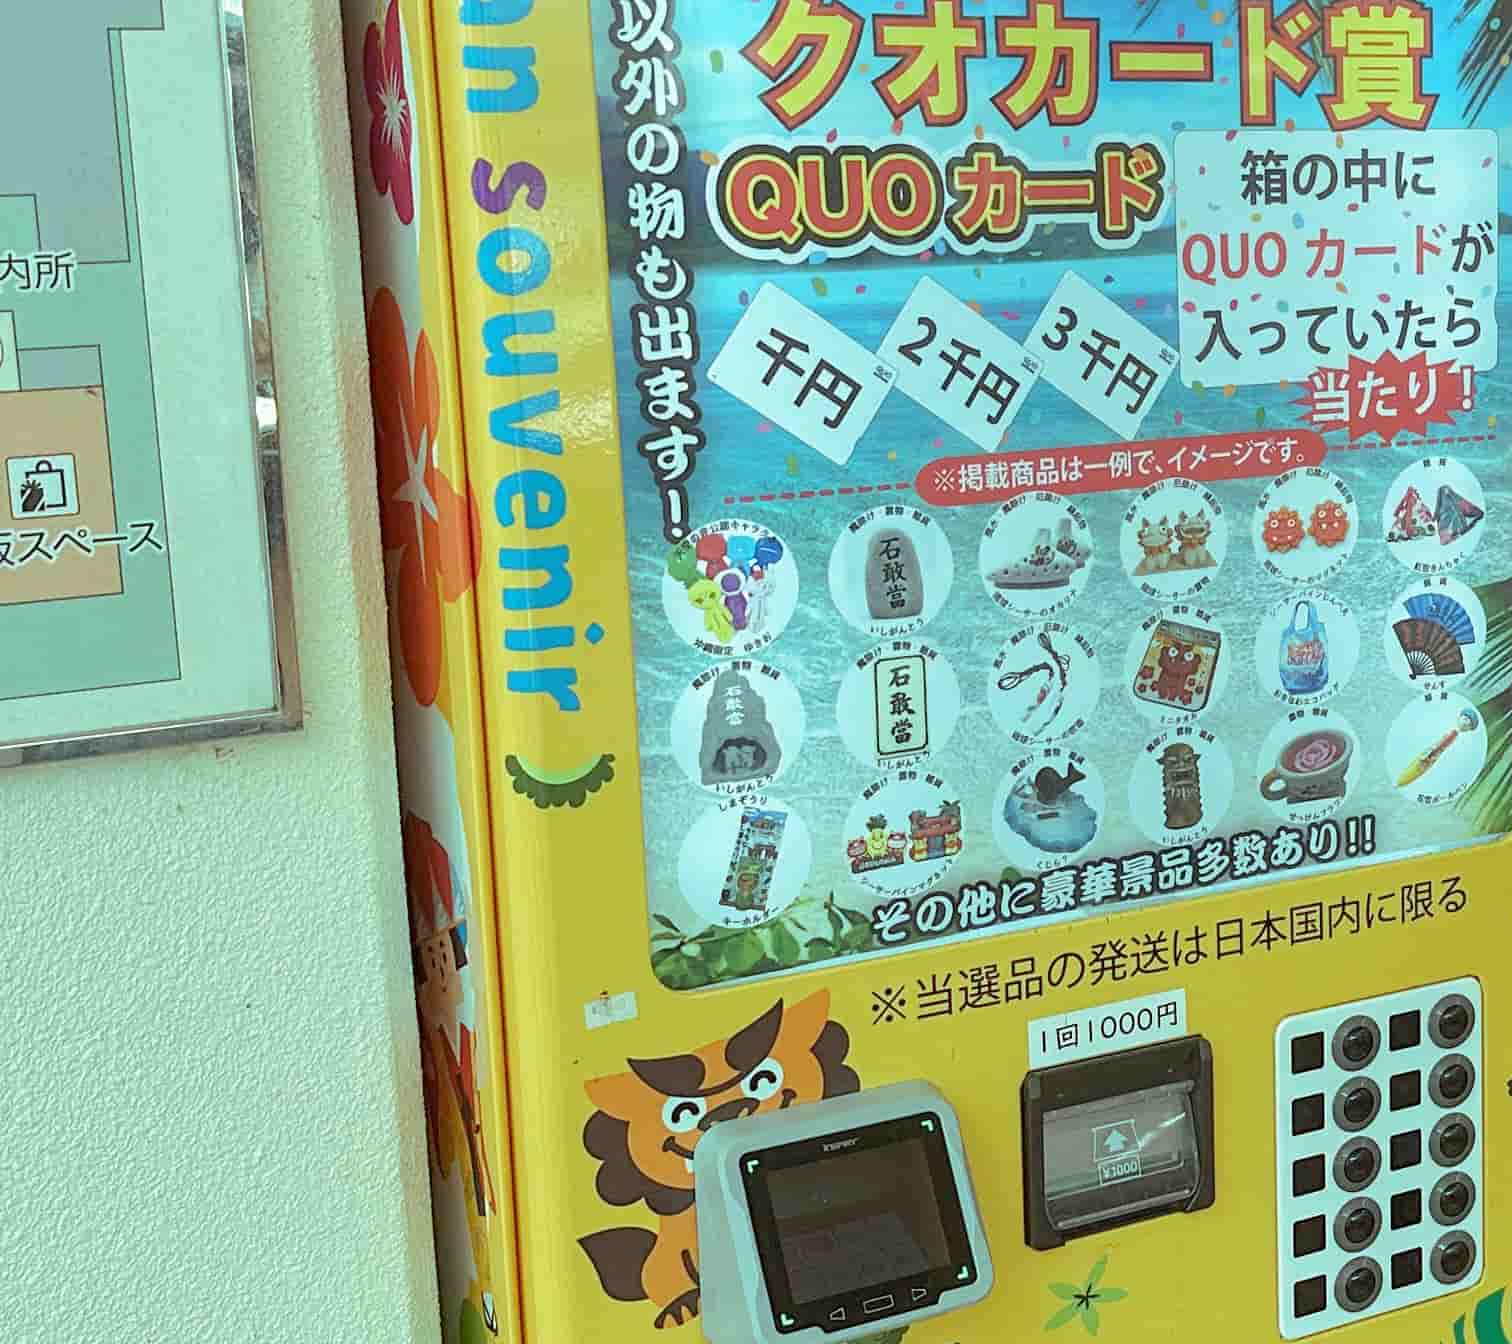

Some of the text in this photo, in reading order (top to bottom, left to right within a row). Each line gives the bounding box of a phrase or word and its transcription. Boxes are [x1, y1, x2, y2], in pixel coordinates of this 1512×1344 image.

[1239, 148, 1438, 207] 箱の中に
[755, 327, 864, 430] 千円
[897, 316, 1021, 425] 2千円
[1042, 306, 1160, 415] 3千円
[1200, 299, 1484, 364] 入っていたら
[471, 157, 605, 712] souvenir
[1310, 363, 1476, 425] 当たり!
[871, 875, 1469, 1025] ※当選品の発送は日本国内に限る
[1040, 1002, 1179, 1052] 1回1000円
